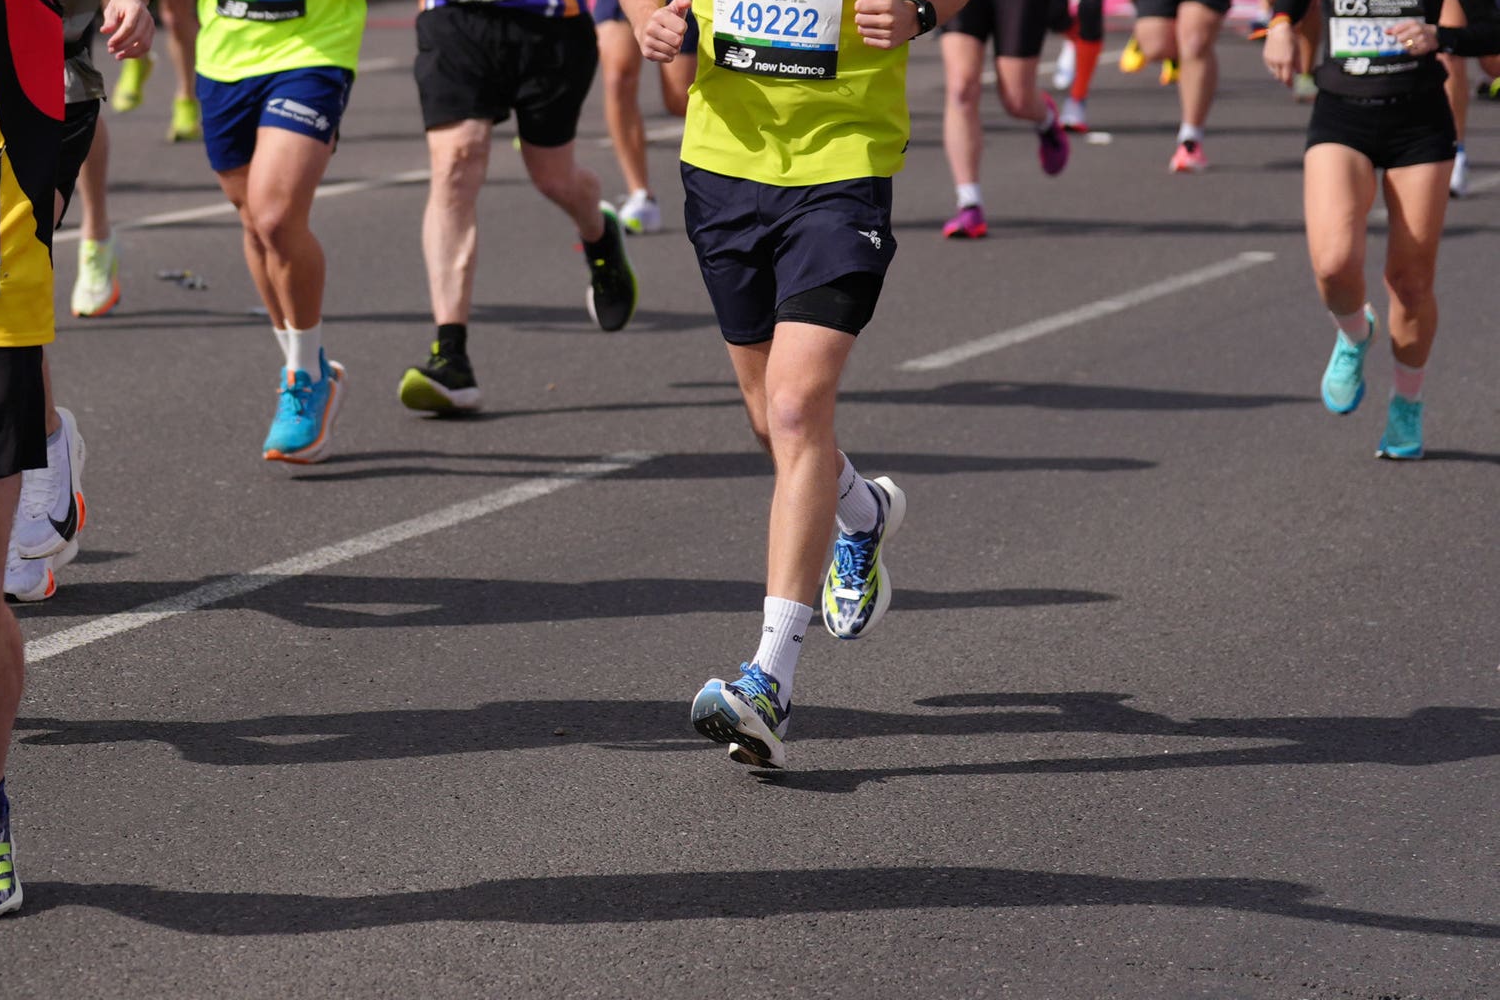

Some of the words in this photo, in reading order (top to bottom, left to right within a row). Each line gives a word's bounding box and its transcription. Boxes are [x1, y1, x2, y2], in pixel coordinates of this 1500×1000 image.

[730, 1, 819, 38] 49222
[754, 60, 778, 71] new
[779, 61, 825, 76] balance
